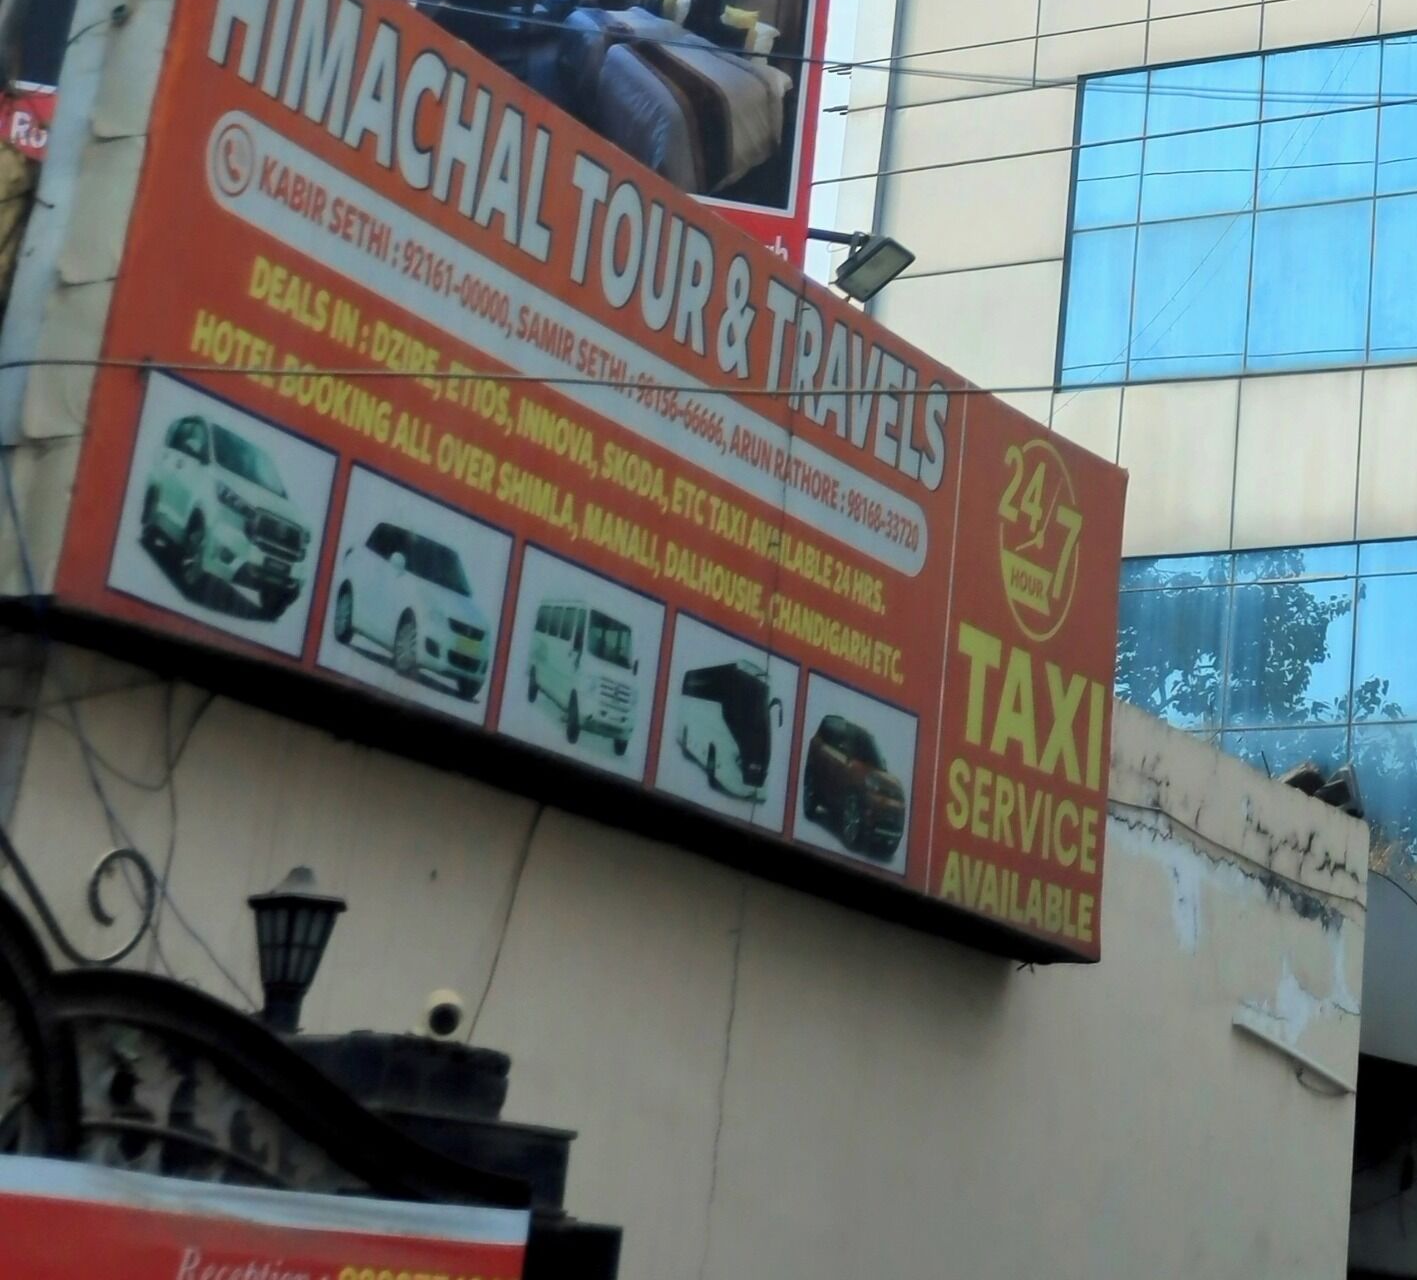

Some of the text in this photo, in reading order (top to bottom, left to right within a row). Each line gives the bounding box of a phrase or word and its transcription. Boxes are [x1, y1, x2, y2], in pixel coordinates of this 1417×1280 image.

[248, 254, 330, 333] DEALS
[329, 298, 361, 349] IN
[370, 319, 443, 401] DZIRE,
[445, 359, 514, 437] ETIOS,
[516, 396, 598, 480] INNOVA,
[600, 441, 669, 514] SKODA,
[670, 476, 706, 525] ETC
[708, 495, 748, 546] TAXI
[747, 518, 833, 587] AVAILABLE
[832, 560, 850, 595] 24
[258, 154, 327, 226] KABIR
[328, 196, 393, 263] SETHI
[402, 240, 513, 339] 92161-00000,
[517, 304, 576, 365] SAMIR
[575, 337, 628, 394] SETHI
[729, 425, 772, 472] ARUN
[773, 447, 840, 508] RATHORE
[846, 488, 919, 552] 98168-33720
[569, 151, 715, 357] TOUR
[716, 254, 757, 381] &
[765, 275, 950, 492] TRAVELS
[190, 308, 905, 685] HOTEL BOOKING ALL OVER SHIMLA, MANALI, DALHOUSIE, CHANDIGARH ETC.
[1010, 565, 1044, 596] HOUR
[946, 757, 1099, 876] SERVICE
[958, 620, 1105, 791] TAXI
[940, 850, 1095, 943] AVAILABLE
